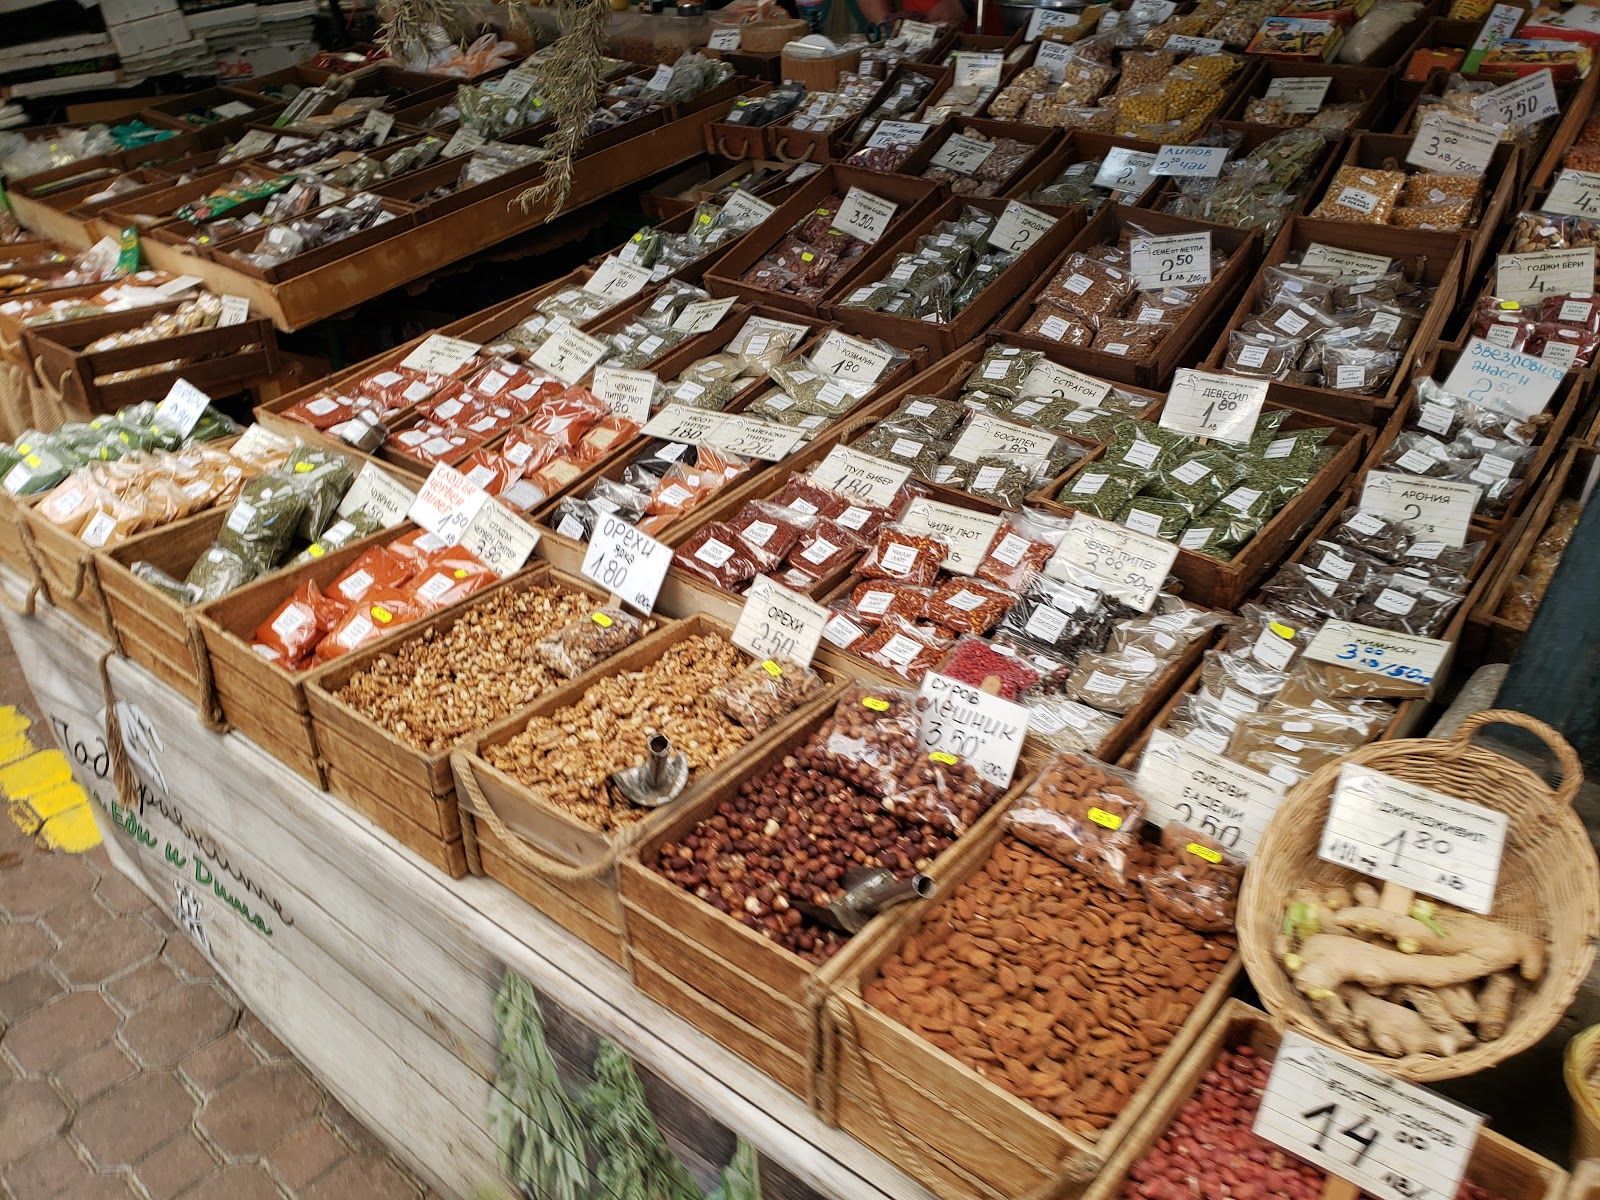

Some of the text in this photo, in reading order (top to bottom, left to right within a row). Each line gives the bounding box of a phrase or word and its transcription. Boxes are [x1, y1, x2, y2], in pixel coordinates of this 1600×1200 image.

[1424, 136, 1442, 156] 3
[1010, 229, 1030, 251] 2
[1159, 259, 1174, 281] 2
[1526, 257, 1585, 273] ГОДЖИ БЕРИ
[1528, 274, 1545, 292] 4
[841, 348, 876, 367] РОЗМАРИН
[1053, 376, 1098, 398] ЕСТРАГОН
[1201, 387, 1250, 402] ДЕВЕСИЛ
[993, 428, 1040, 450] БОСИЛЕК
[844, 463, 866, 478] ПУЛ
[867, 471, 894, 487] БИБЕР
[1400, 489, 1452, 505] АРОНИЯ
[956, 527, 982, 541] ЛЮТ
[1083, 537, 1158, 574] ЧЕРЕН ПИПЕР
[767, 606, 805, 633] ОРЕХИ
[1335, 642, 1359, 662] 3
[931, 677, 981, 705] СУРОВ
[1191, 769, 1251, 804] СУРОВИ
[1181, 786, 1247, 824] БАДЕМИ
